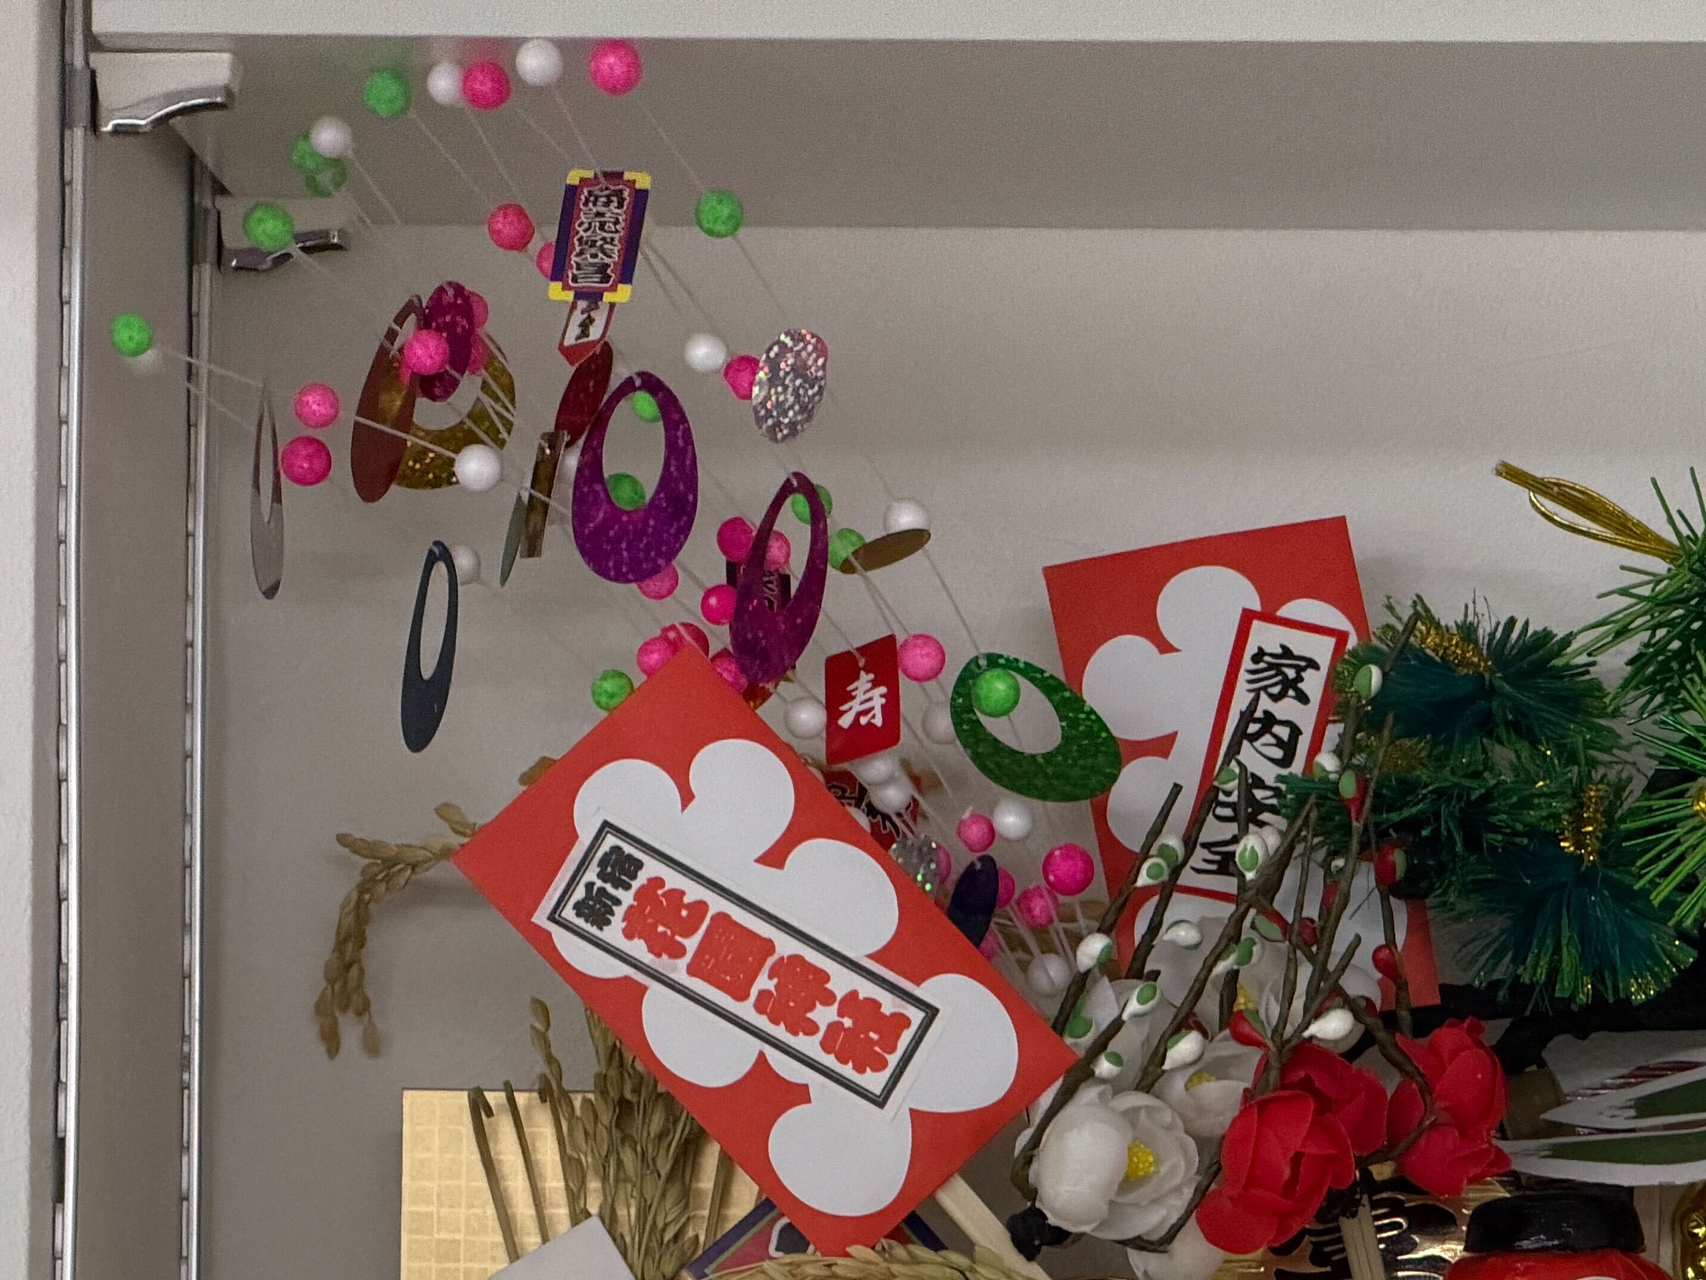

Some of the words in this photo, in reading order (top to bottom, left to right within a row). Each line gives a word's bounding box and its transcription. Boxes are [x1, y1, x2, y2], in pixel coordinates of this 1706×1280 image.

[838, 671, 887, 727] 寿
[573, 845, 644, 931] 新宿
[622, 876, 912, 1075] 花園神社
